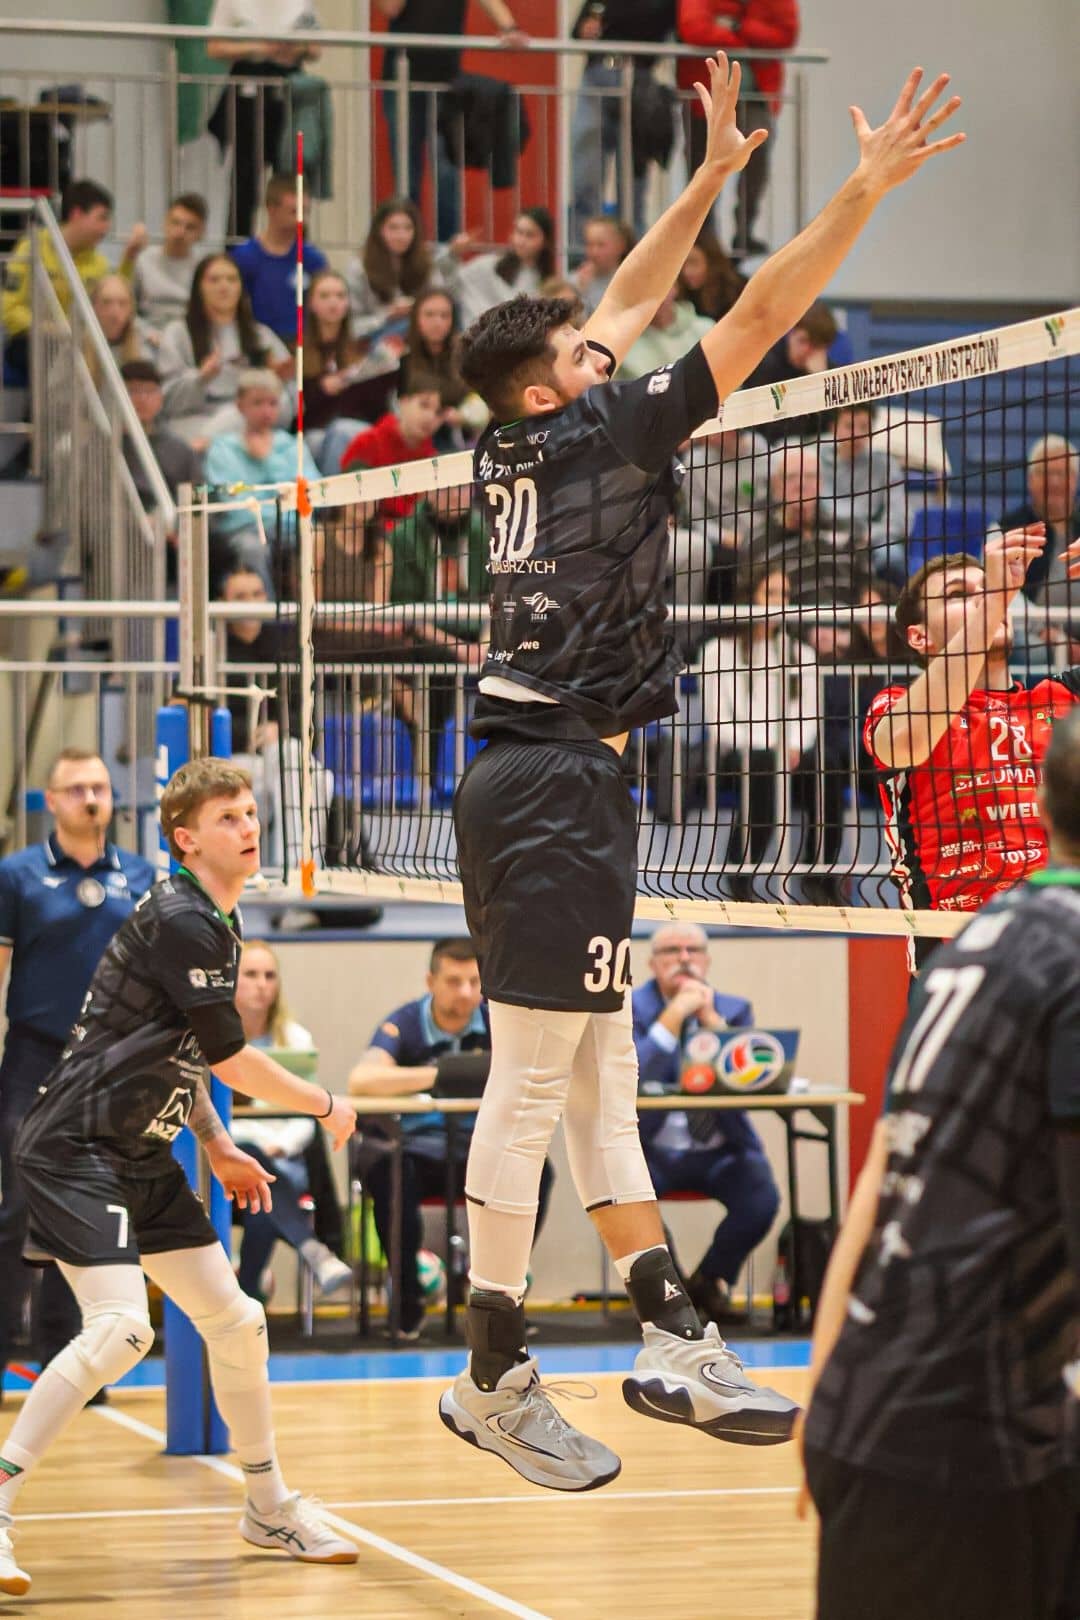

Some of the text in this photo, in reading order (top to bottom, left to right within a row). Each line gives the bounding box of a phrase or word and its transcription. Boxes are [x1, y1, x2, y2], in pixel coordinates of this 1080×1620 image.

[823, 336, 999, 407] HALA WAŁBRZYSKICH MISTRZÓW
[485, 477, 538, 560] 30
[989, 716, 1032, 760] 28
[584, 935, 632, 993] 30
[891, 964, 986, 1094] 11
[106, 1204, 129, 1249] 7
